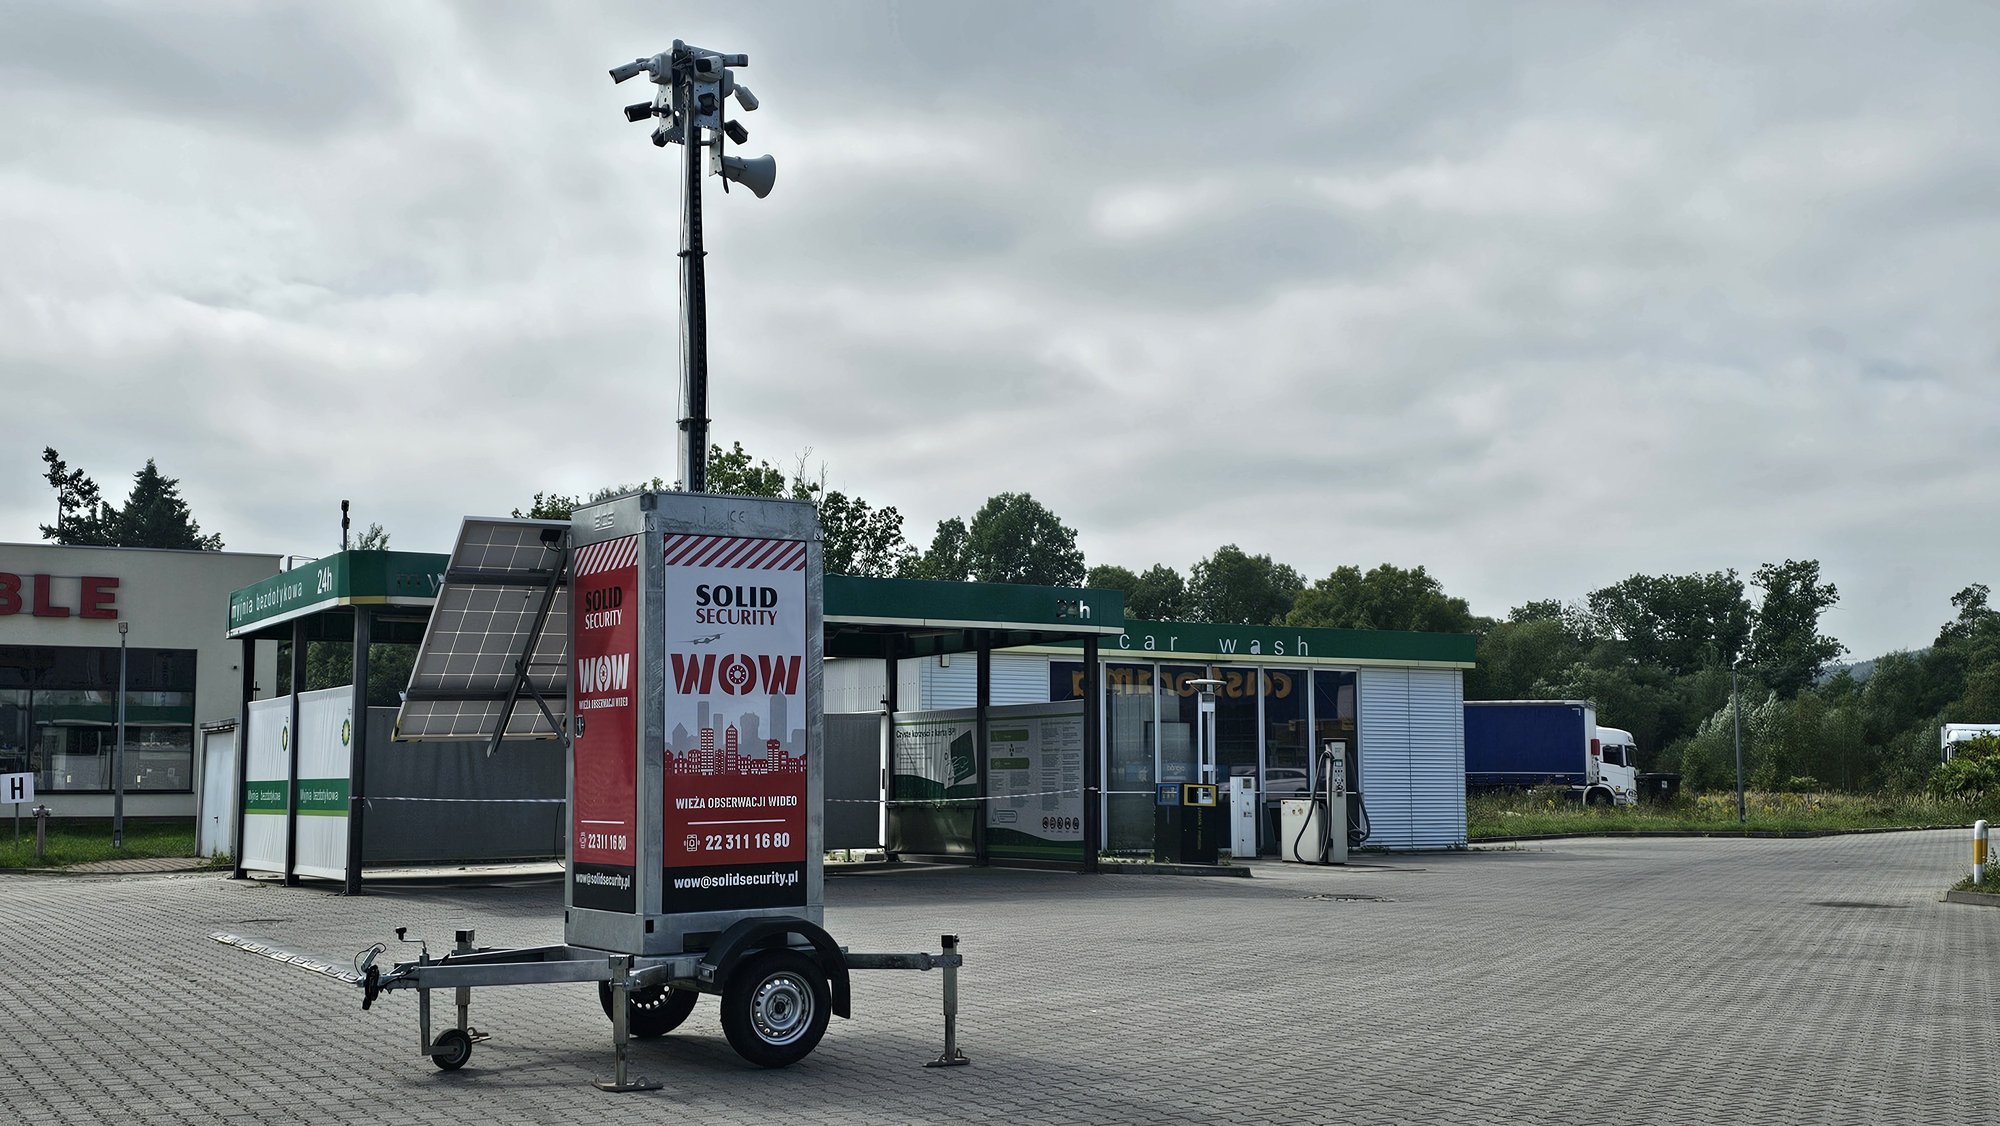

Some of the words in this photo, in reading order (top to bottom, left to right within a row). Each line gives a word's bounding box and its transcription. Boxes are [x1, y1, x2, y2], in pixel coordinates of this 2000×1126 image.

[0, 572, 119, 619] BLE
[232, 599, 253, 622] myjnia
[256, 581, 302, 612] bezdotykowa
[317, 566, 332, 594] 24h
[585, 586, 622, 612] SOLID
[696, 584, 778, 608] SOLID
[585, 609, 622, 630] SECURITY
[696, 608, 778, 626] SECURITY
[1119, 634, 1178, 650] car
[1219, 636, 1309, 656] wash
[579, 653, 630, 694] WOW
[670, 653, 802, 696] WOW
[10, 776, 24, 800] H
[676, 796, 706, 810] WIEŻA
[708, 796, 766, 808] OBSERWACJI
[768, 795, 798, 807] WIDEO
[588, 834, 596, 849] 22
[596, 834, 608, 850] 311
[610, 834, 617, 850] 16
[618, 834, 627, 850] 80
[705, 834, 723, 851] 22
[725, 833, 750, 850] 311
[754, 832, 771, 849] 16
[773, 832, 790, 848] 80
[674, 870, 799, 889] wow@solidsecurity.pl
